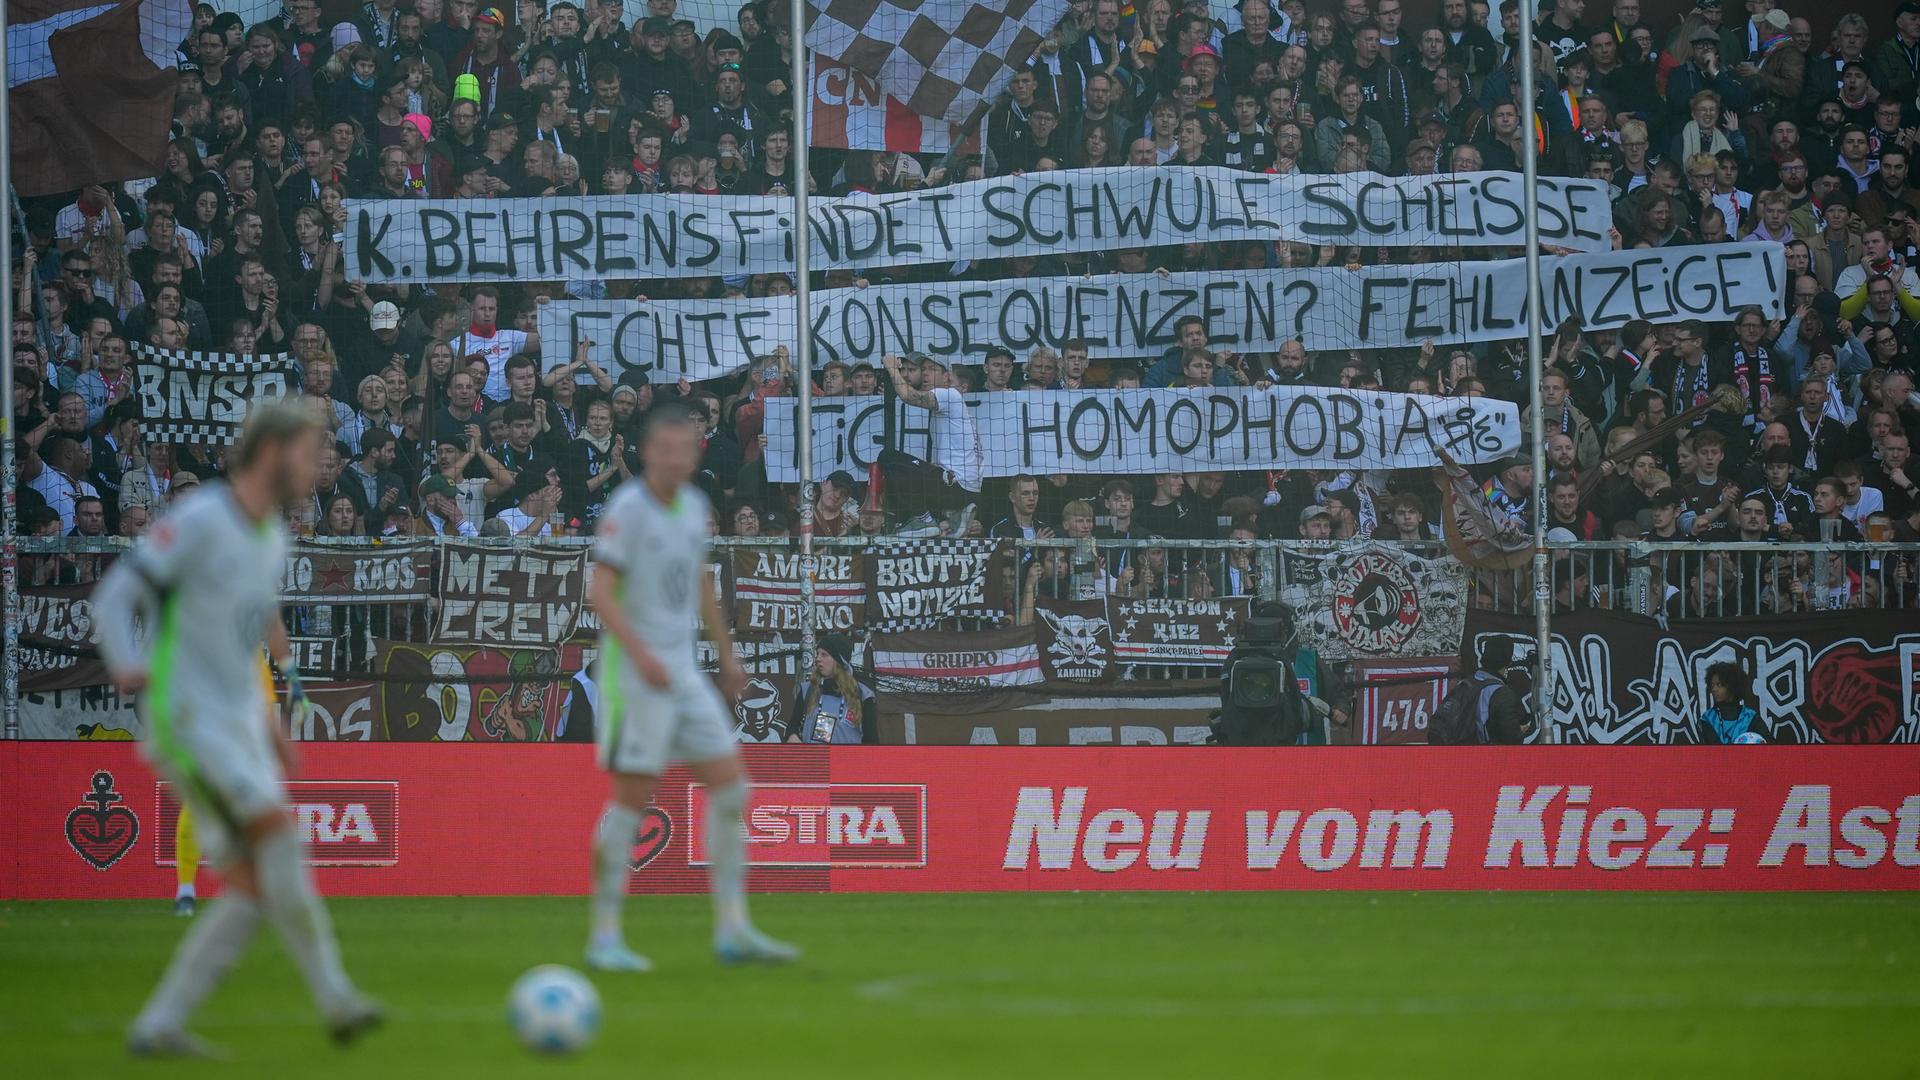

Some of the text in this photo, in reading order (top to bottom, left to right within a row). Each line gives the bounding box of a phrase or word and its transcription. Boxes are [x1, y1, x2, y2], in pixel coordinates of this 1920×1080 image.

[417, 206, 721, 277] BEHRENS
[981, 175, 1280, 246] SCHWULE
[446, 551, 581, 599] METT
[876, 576, 987, 618] NOTIZIE
[440, 599, 580, 643] CREW
[922, 651, 998, 668] GRUPPO
[1379, 699, 1429, 723] 476
[1002, 786, 1211, 872] Neu
[1245, 807, 1455, 872] vom
[1483, 785, 1736, 869] Kiez:
